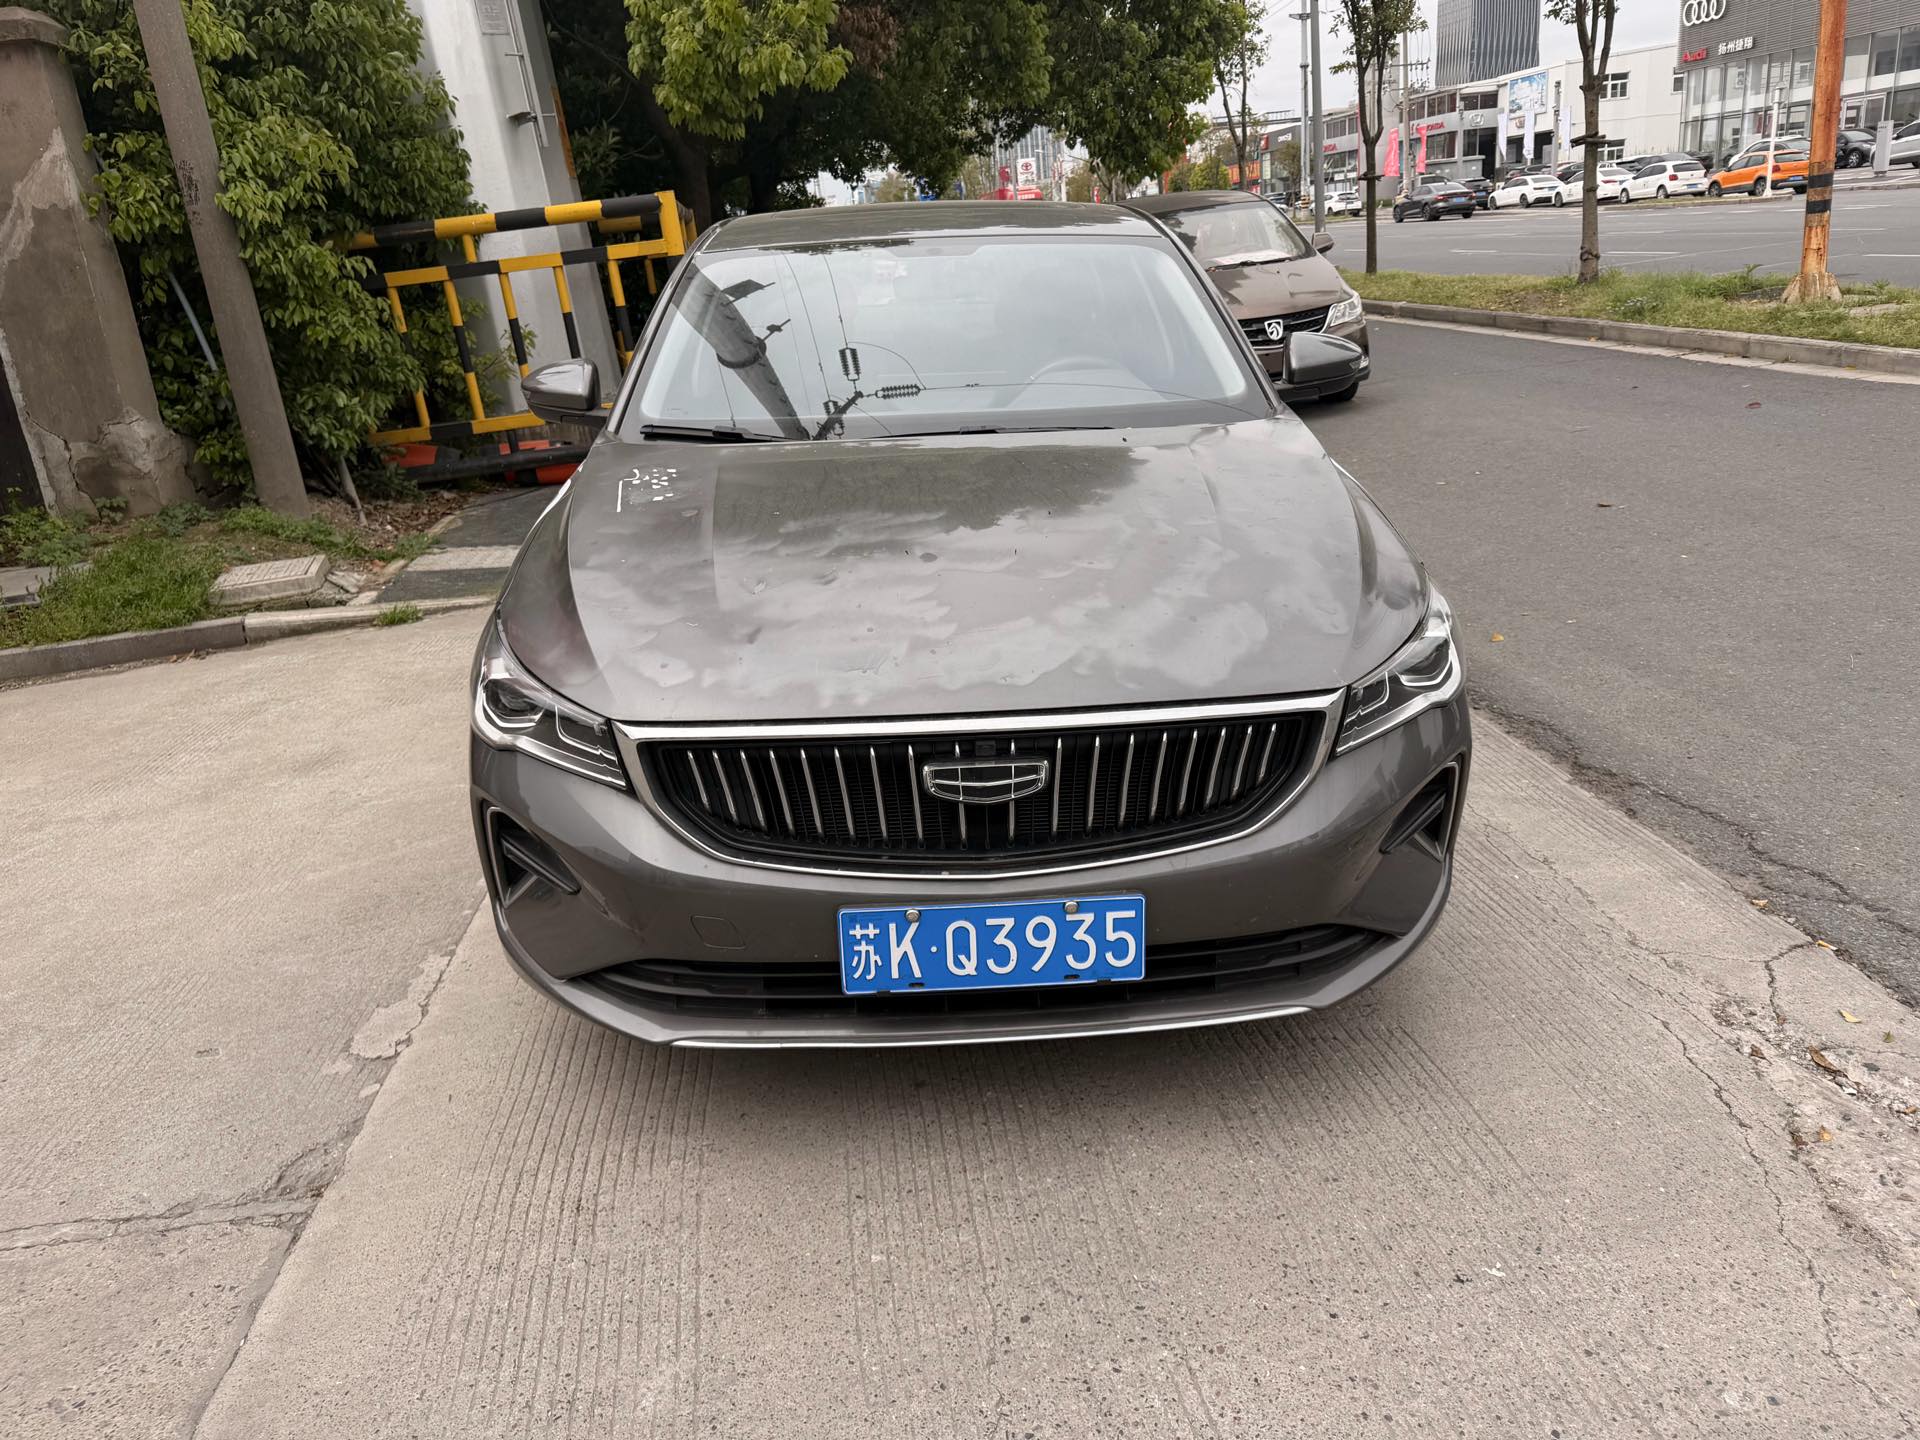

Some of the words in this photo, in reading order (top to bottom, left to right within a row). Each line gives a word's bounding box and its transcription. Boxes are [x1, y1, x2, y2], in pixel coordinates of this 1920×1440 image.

[1718, 36, 1753, 55] 扬州捷翔
[848, 910, 1137, 980] 苏K·Q3935
